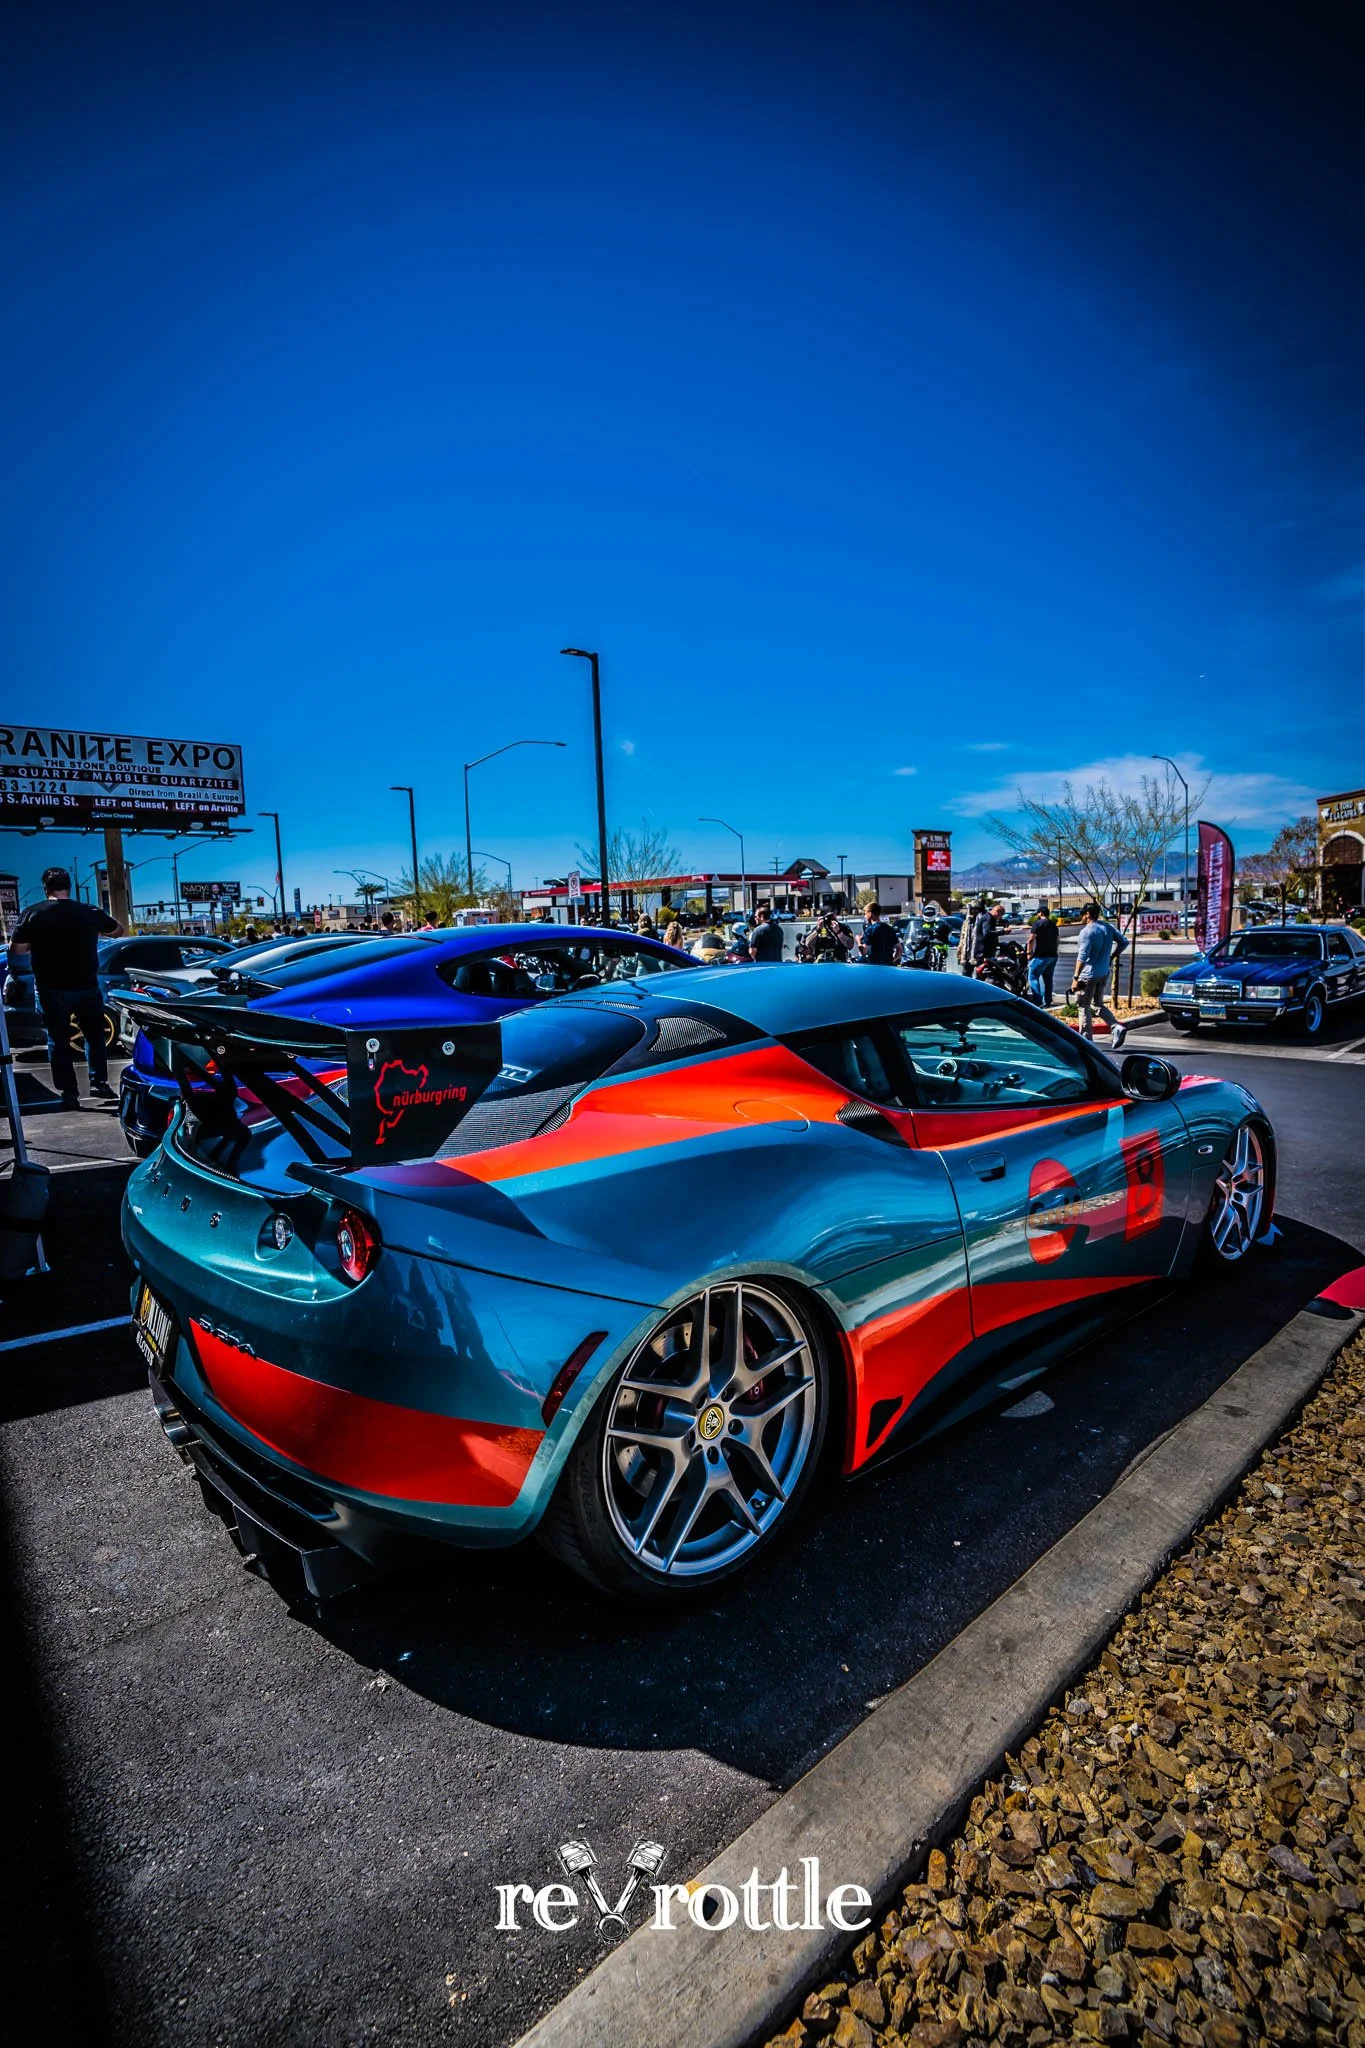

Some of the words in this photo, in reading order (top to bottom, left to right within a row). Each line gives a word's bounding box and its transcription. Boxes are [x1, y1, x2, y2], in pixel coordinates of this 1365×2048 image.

[0, 728, 133, 763] RANITE
[147, 740, 236, 771] EXPO
[44, 759, 65, 768] THE
[70, 761, 105, 770] STONE
[109, 764, 161, 774] BOUTIQUE
[18, 767, 80, 780] QUARTZ
[93, 772, 149, 784] MARBLE
[160, 776, 234, 789] QUARTZITE
[7, 793, 19, 804] S.
[21, 794, 59, 806] Arville
[63, 795, 79, 807] St.
[95, 798, 117, 807] LEFT
[134, 800, 169, 811] Sunset,
[175, 803, 196, 811] LEFT
[211, 804, 239, 813] Arville
[128, 788, 154, 796] Direct
[157, 790, 175, 798] from
[178, 791, 201, 799] Brazil
[213, 793, 239, 802] Europe
[1141, 914, 1178, 924] LUNCH
[1142, 923, 1178, 931] SPECIALS
[392, 1085, 467, 1107] nürburgring
